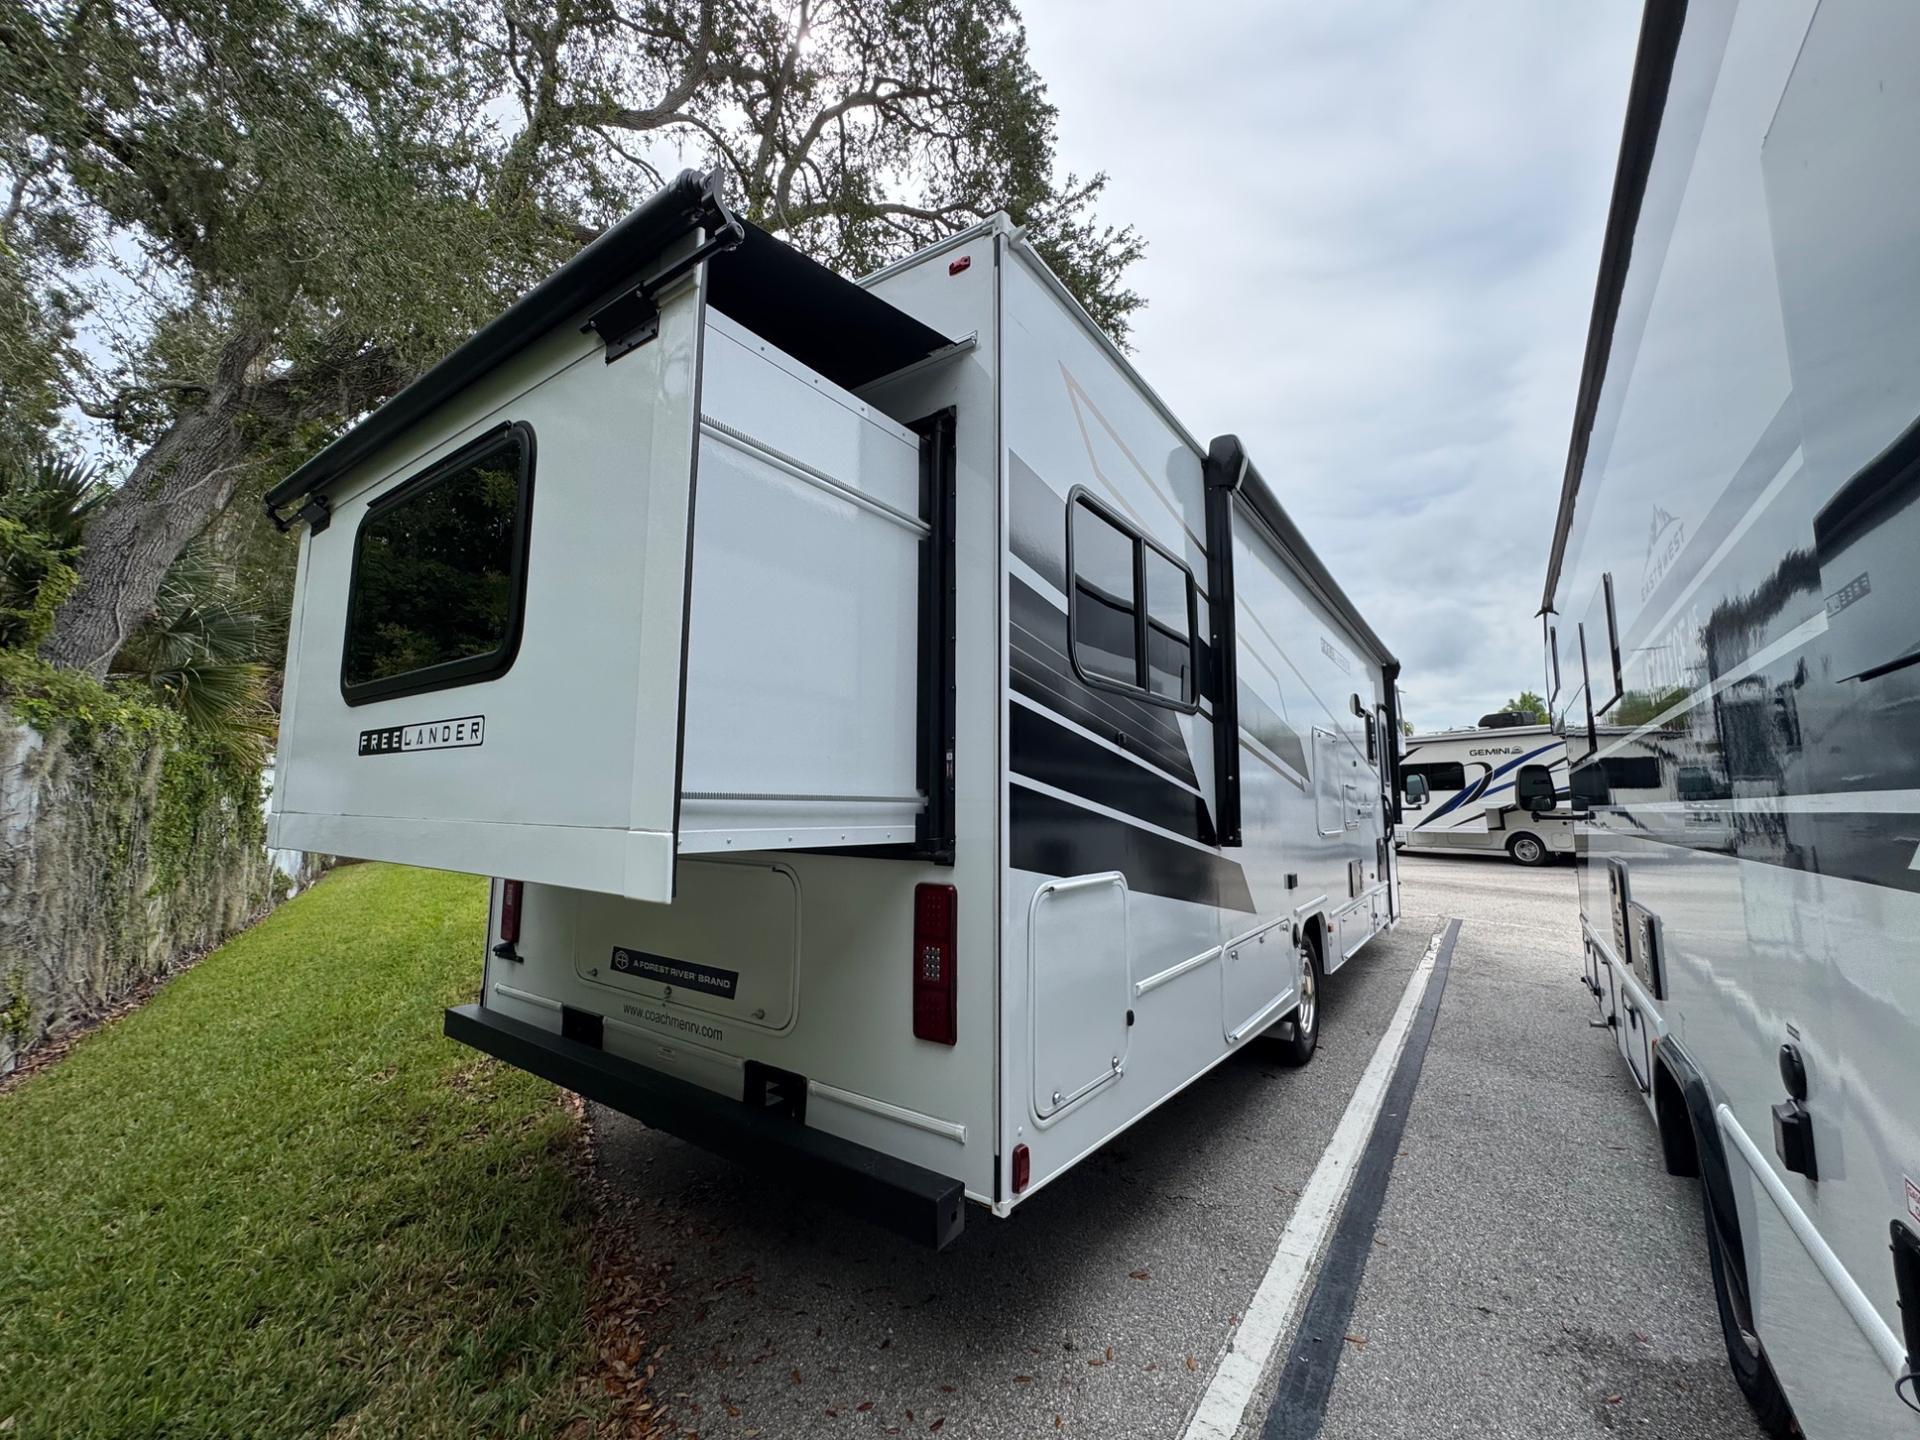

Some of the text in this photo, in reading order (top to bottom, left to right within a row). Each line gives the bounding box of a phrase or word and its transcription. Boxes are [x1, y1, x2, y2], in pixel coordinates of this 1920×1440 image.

[360, 721, 480, 752] FREELANDER
[1469, 747, 1510, 757] GEMINI
[632, 959, 731, 989] A FOREST RIVER BRAND
[623, 1003, 723, 1041] www.coachmenrv.com
